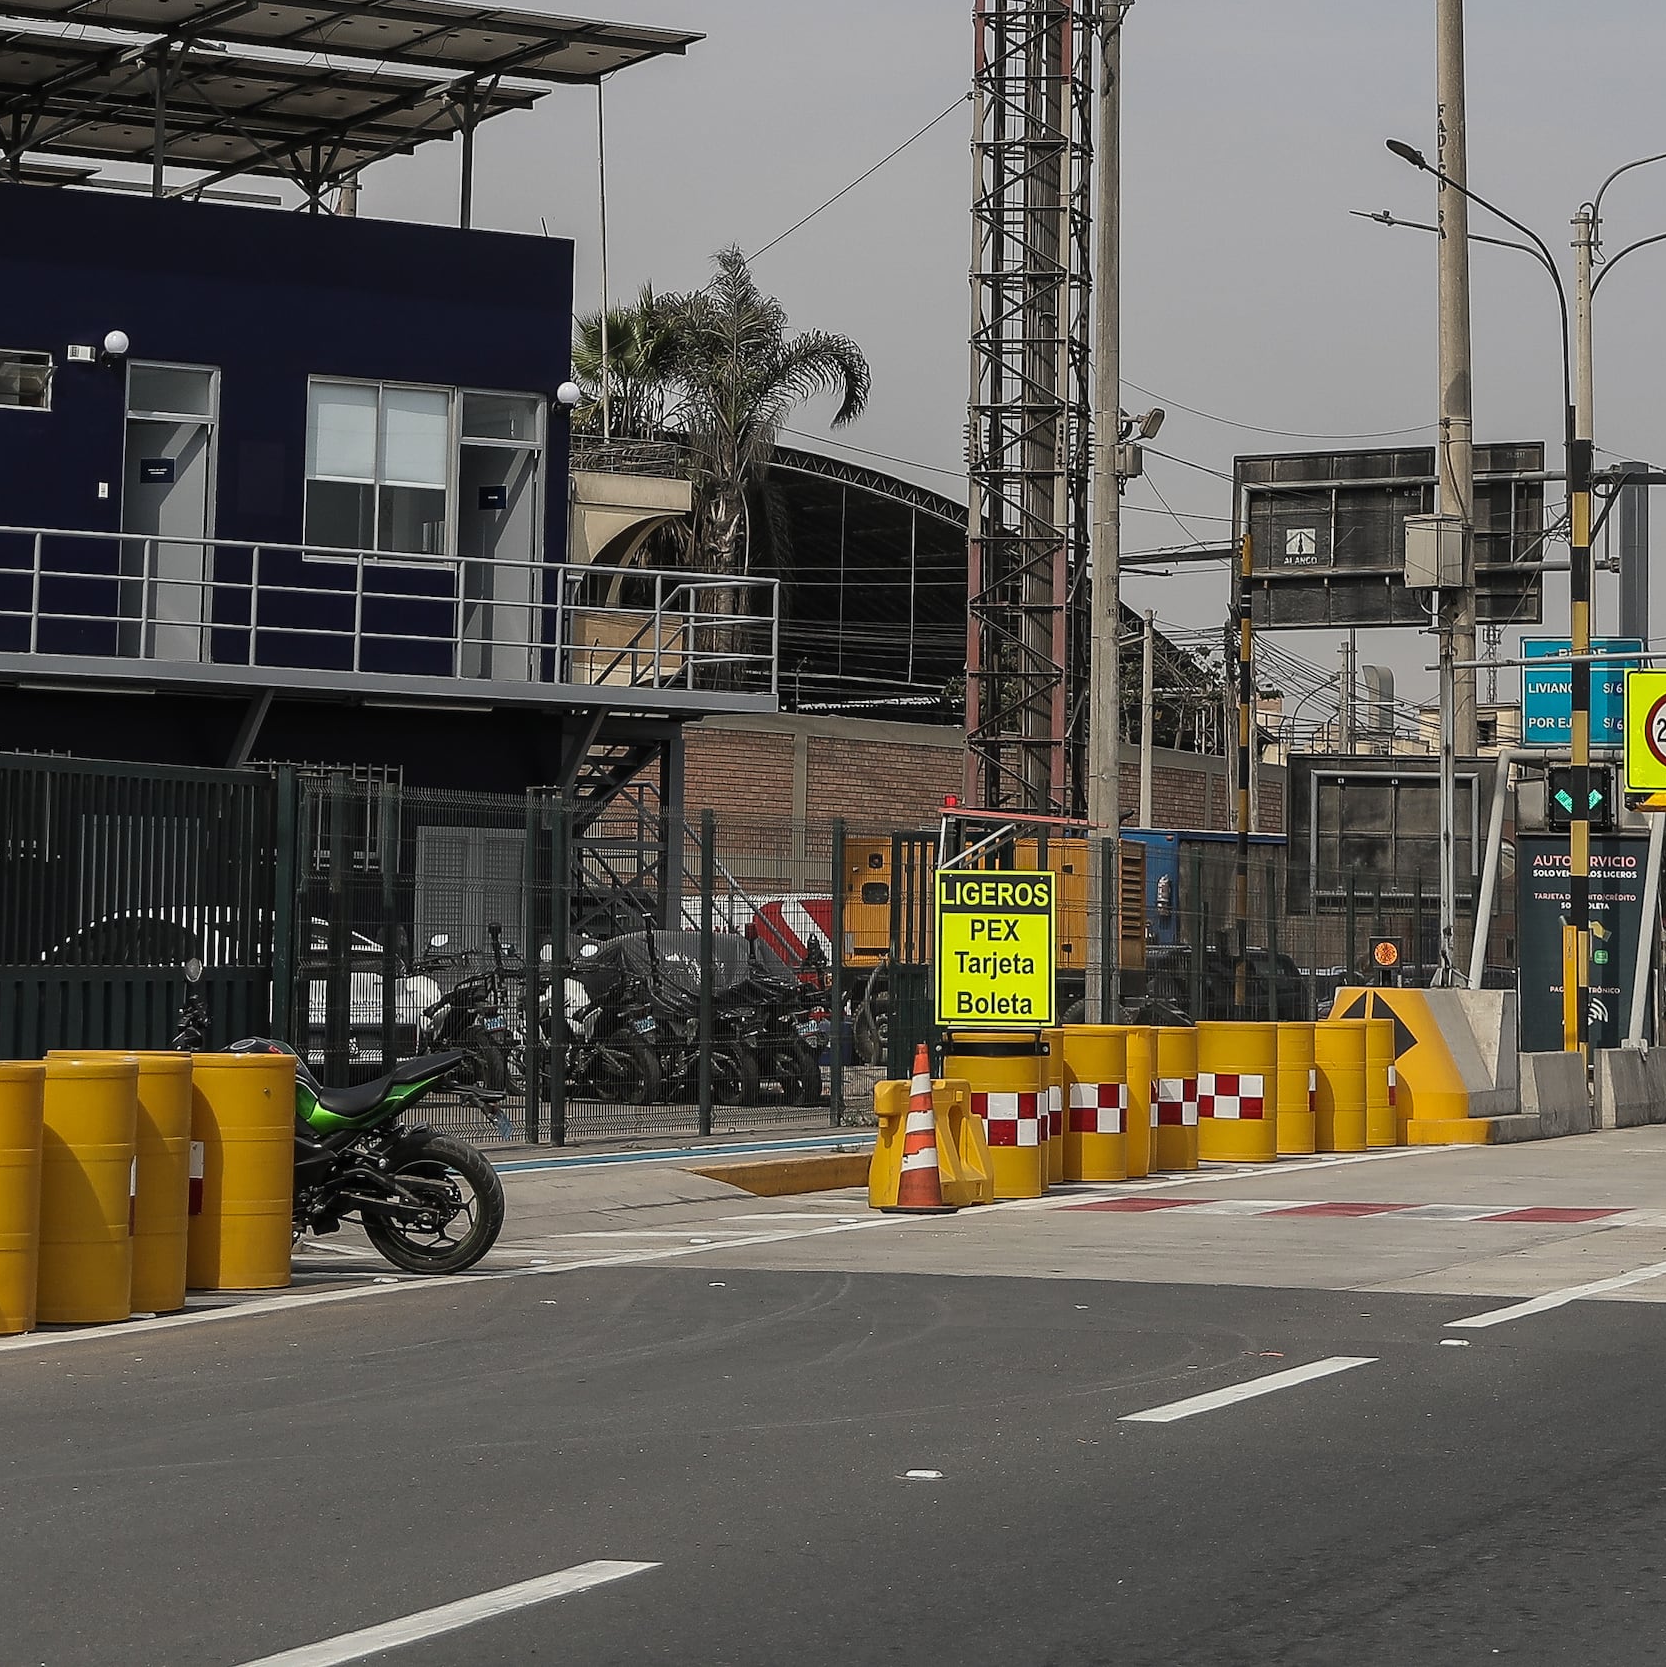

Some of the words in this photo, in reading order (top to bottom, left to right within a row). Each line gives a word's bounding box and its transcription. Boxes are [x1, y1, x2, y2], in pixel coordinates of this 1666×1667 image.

[1528, 717, 1555, 729] POR
[1533, 855, 1637, 868] AUTORVICIO
[1533, 869, 1555, 878] SOLO
[1603, 870, 1637, 879] LIGEROS
[941, 881, 1049, 907] LIGEROS
[1534, 892, 1564, 901] TARJETA
[970, 918, 1020, 941] PEX
[954, 951, 1034, 980] Tarjeta
[957, 991, 1032, 1015] Boleta
